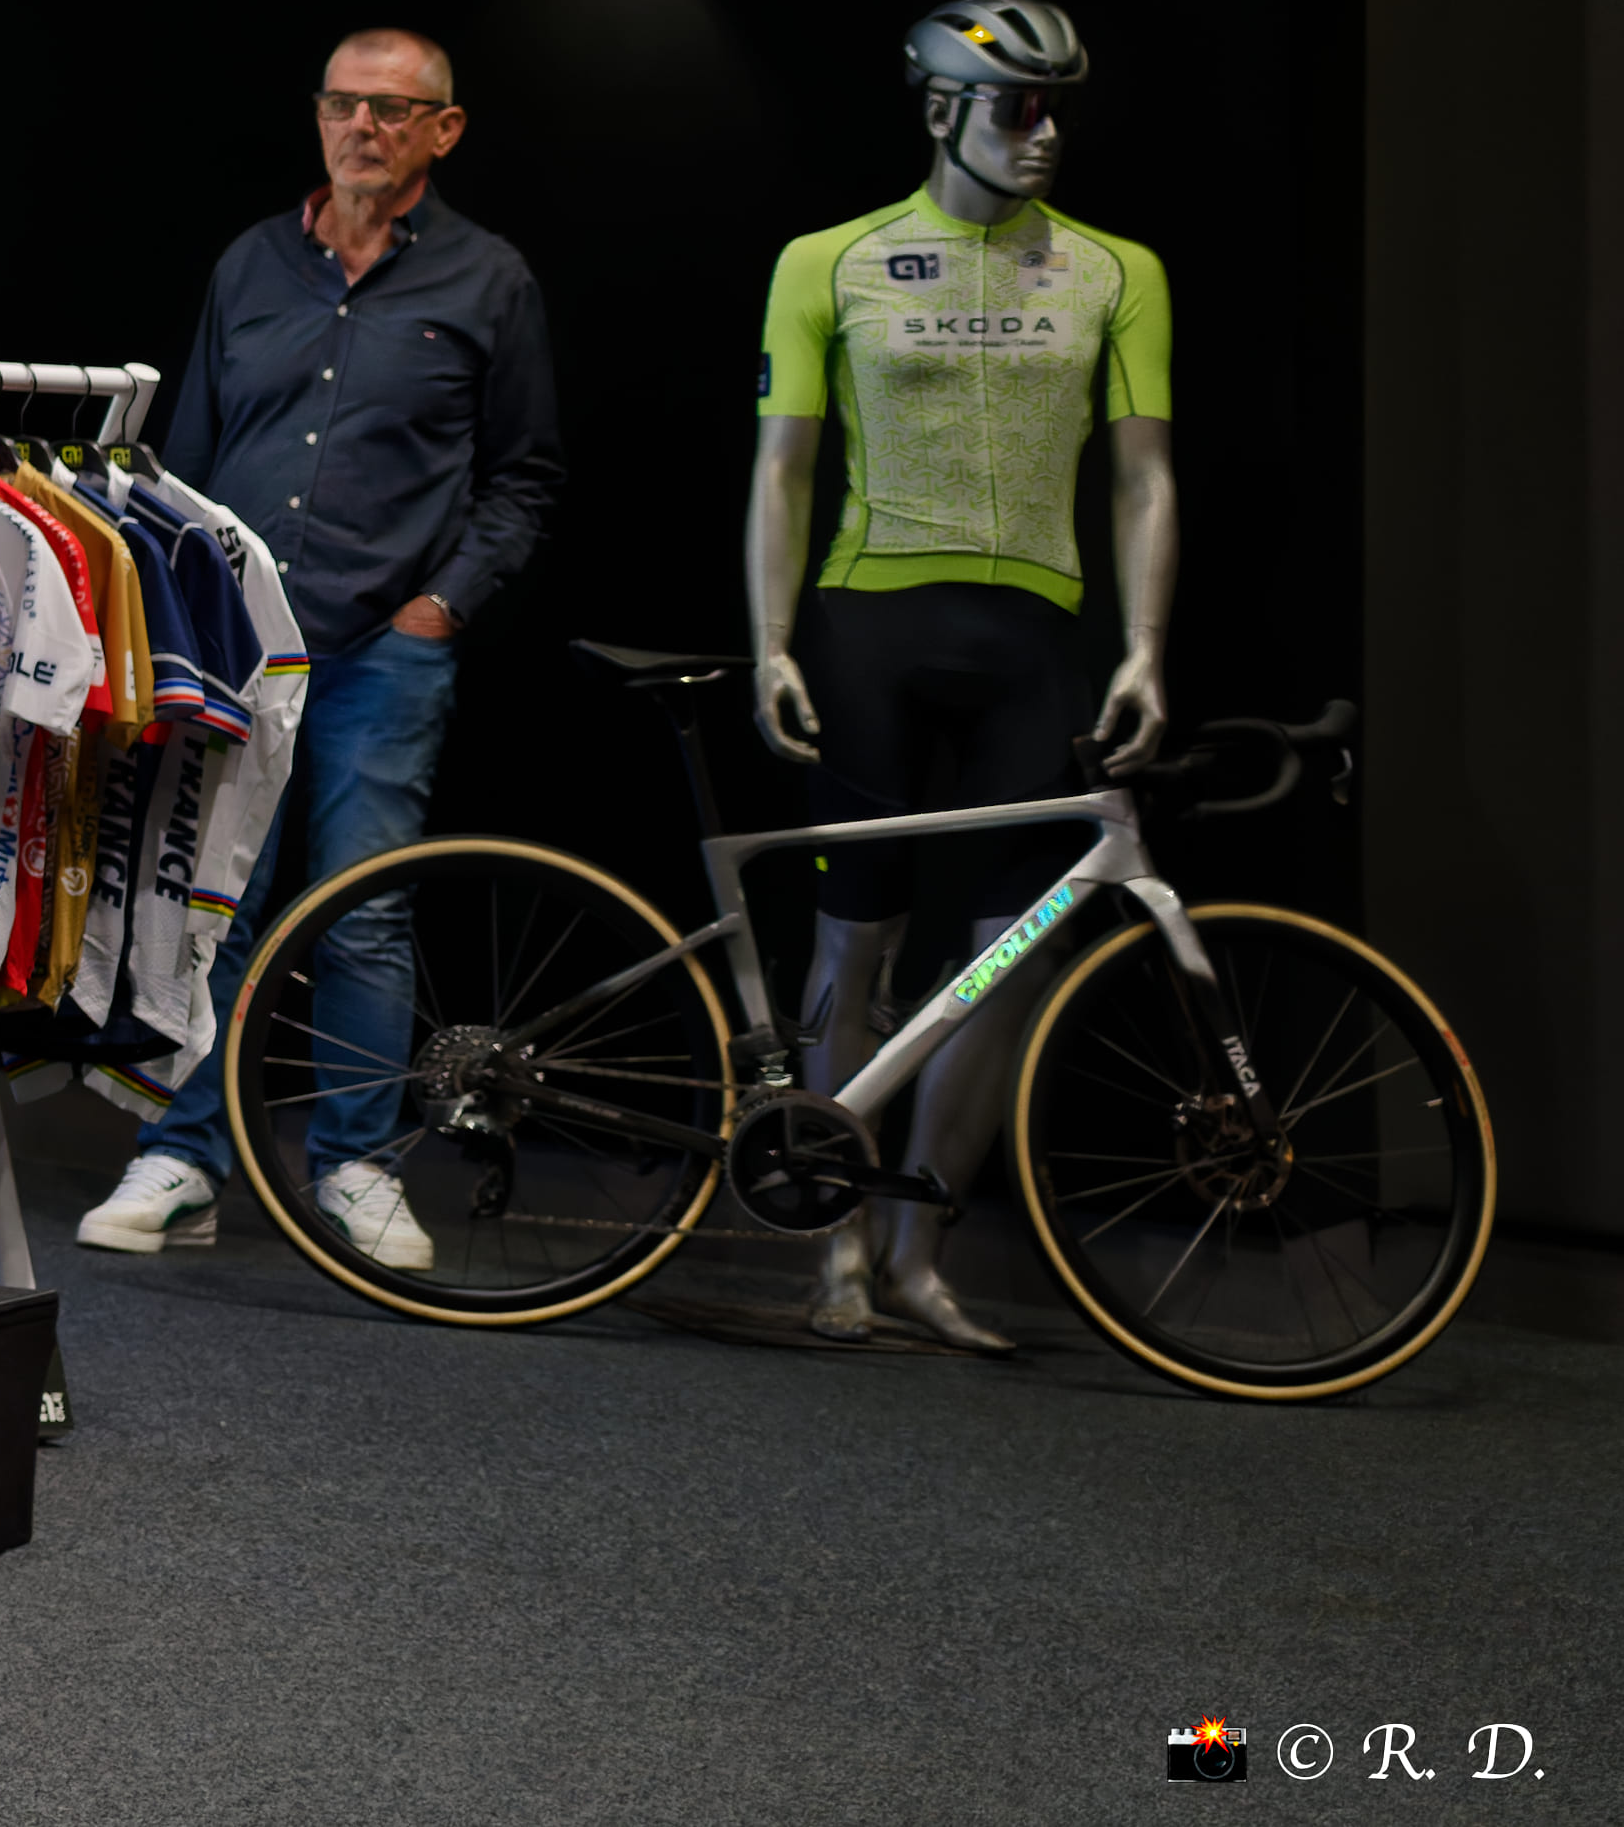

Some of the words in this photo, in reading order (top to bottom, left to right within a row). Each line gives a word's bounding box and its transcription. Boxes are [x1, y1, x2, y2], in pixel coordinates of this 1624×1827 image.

[904, 316, 1057, 335] SKODA
[954, 883, 1074, 1004] CIPOLLINI
[1221, 1035, 1262, 1099] ITACA
